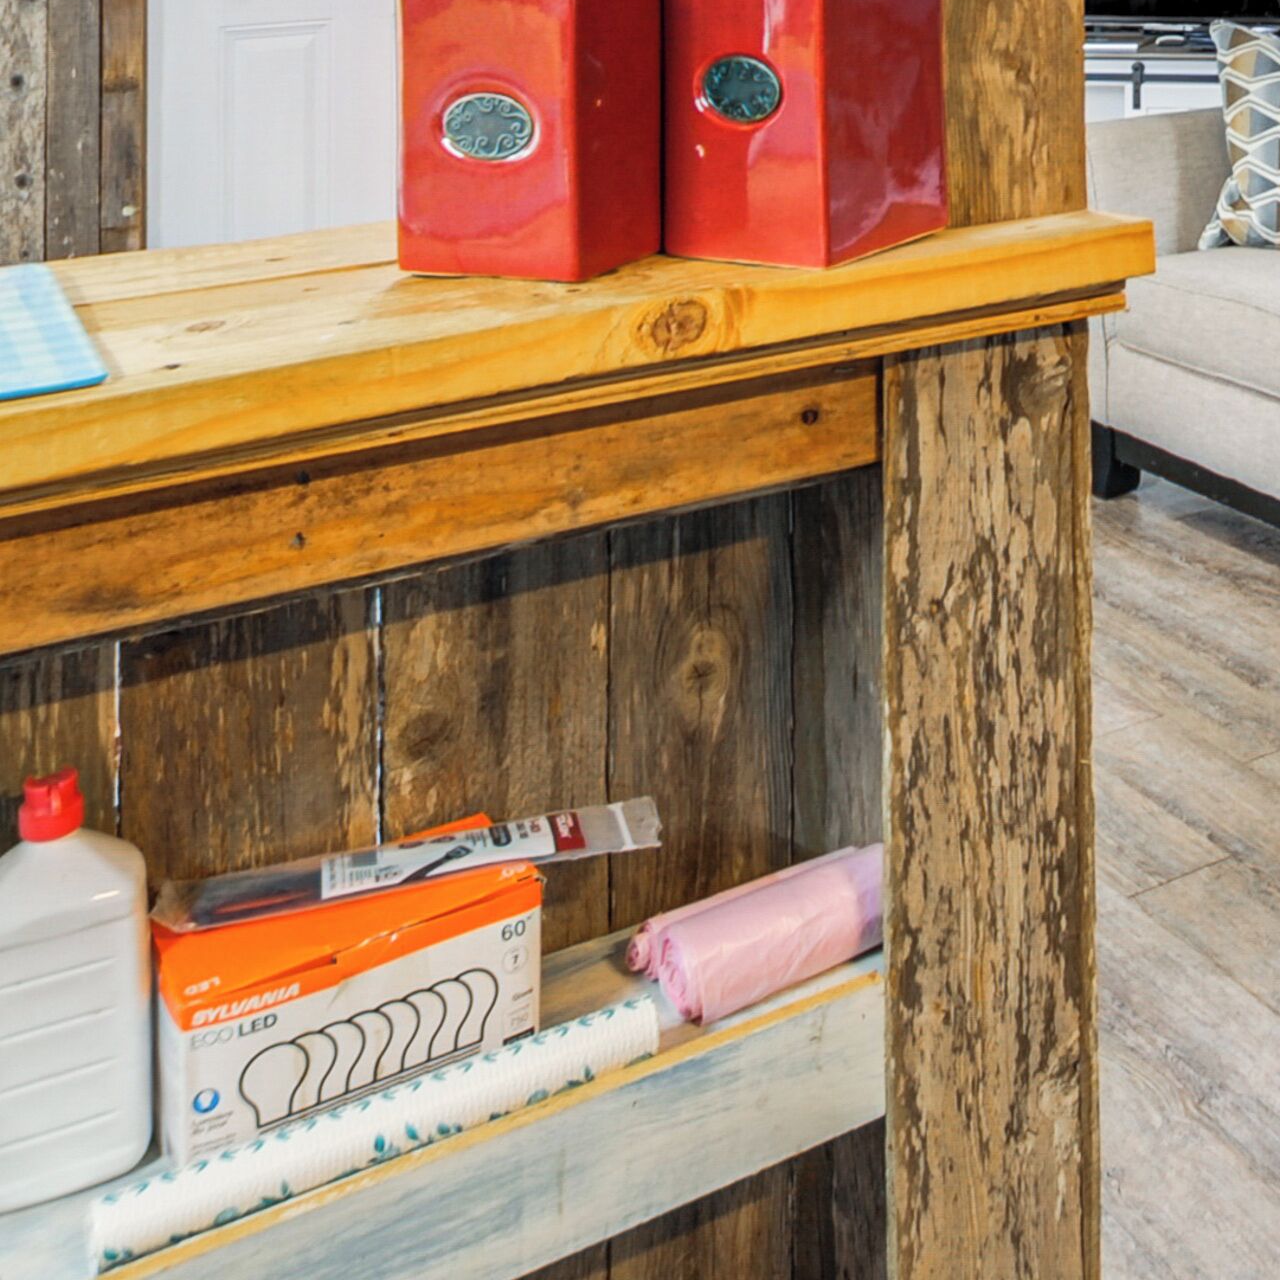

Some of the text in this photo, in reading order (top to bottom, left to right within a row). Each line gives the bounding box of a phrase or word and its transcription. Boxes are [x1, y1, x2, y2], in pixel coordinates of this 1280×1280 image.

[190, 981, 301, 1027] SYLVANIA
[190, 1012, 278, 1051] ECO LED
